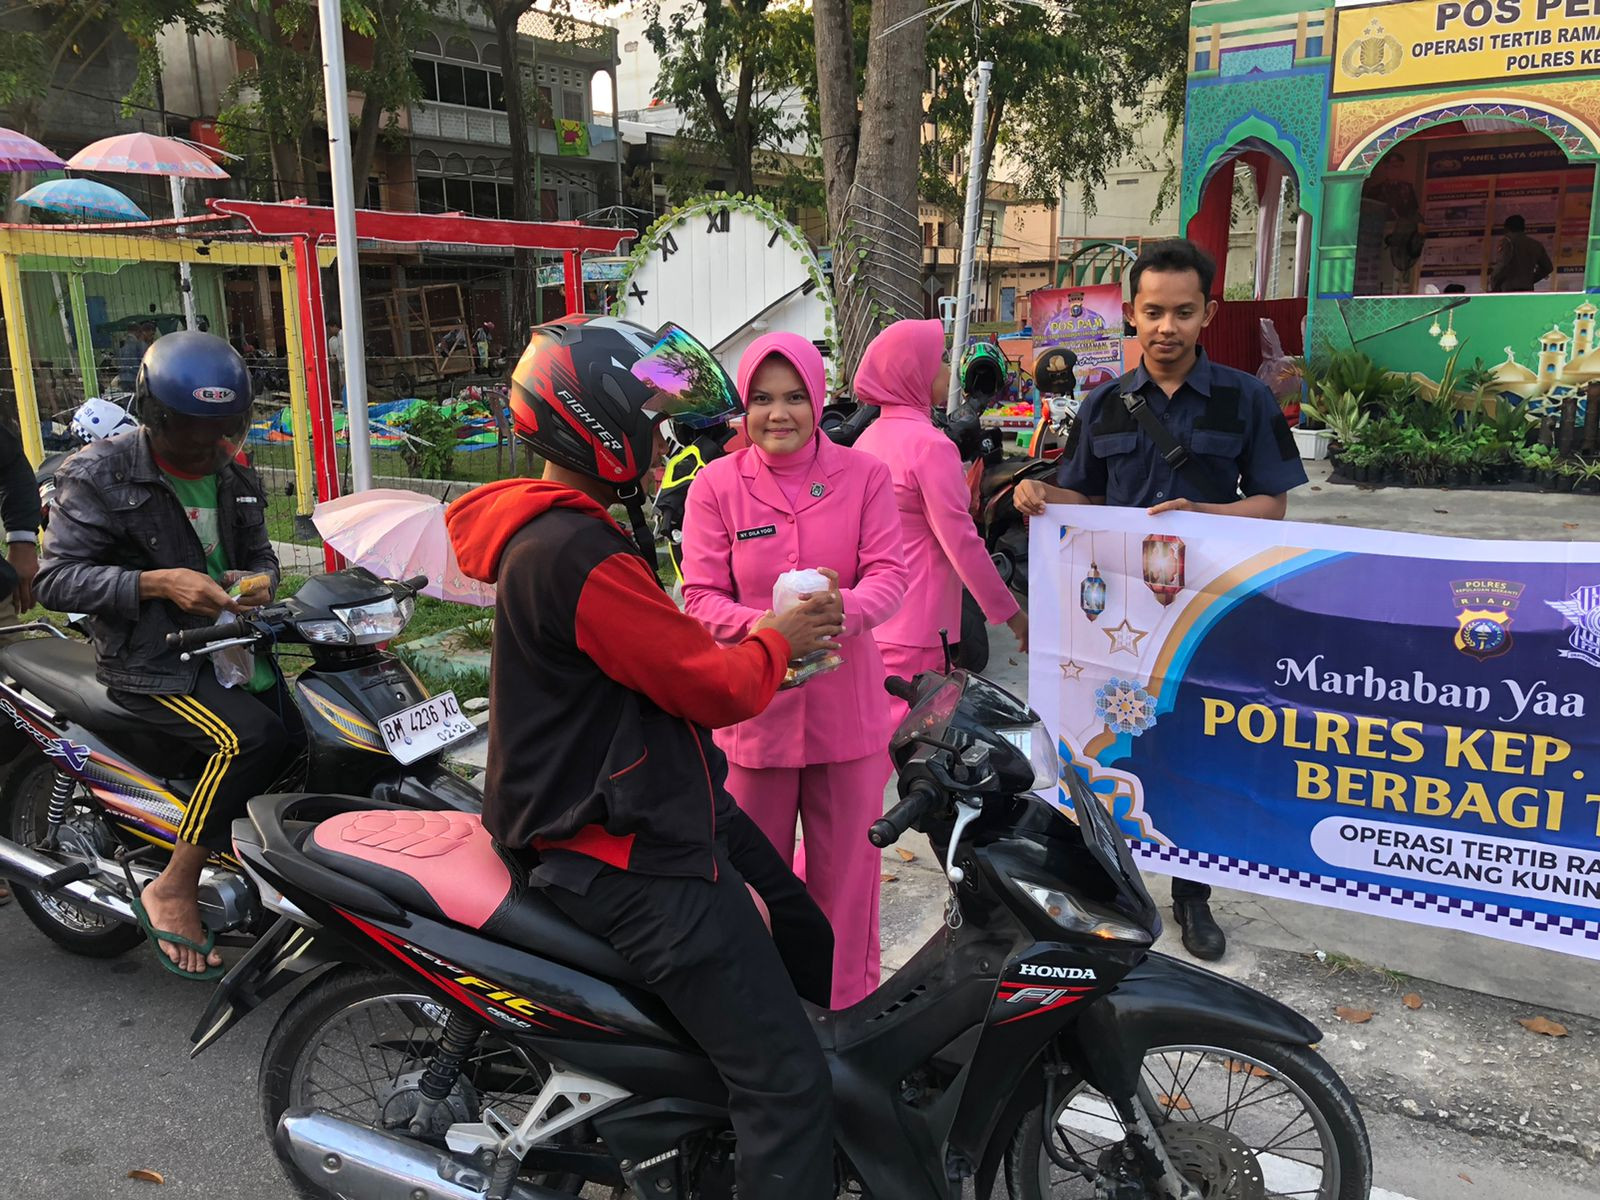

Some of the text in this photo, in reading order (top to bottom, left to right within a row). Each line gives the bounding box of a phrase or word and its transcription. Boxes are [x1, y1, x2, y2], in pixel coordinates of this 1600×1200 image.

[1436, 0, 1600, 31] POS PE
[1412, 37, 1484, 57] OPERASI
[1490, 30, 1552, 50] TERTIB
[1507, 52, 1575, 71] POLRES
[1463, 153, 1495, 162] PANEL
[1499, 152, 1526, 160] DATA
[1051, 317, 1103, 331] POS PAM
[557, 389, 623, 450] FIGHTER
[1466, 581, 1507, 590] POLRES
[1274, 654, 1585, 722] Marhaban Yaa
[383, 696, 458, 743] BM 4236 XC
[1202, 697, 1585, 780] POLRES KEP.
[1294, 760, 1565, 831] BERBAGI
[1339, 824, 1453, 855] OPERASI
[1461, 839, 1557, 870] TERTIB
[1373, 850, 1600, 900] LANCANG KUNIN
[1019, 963, 1097, 980] HONDA
[1006, 987, 1068, 1006] FI
